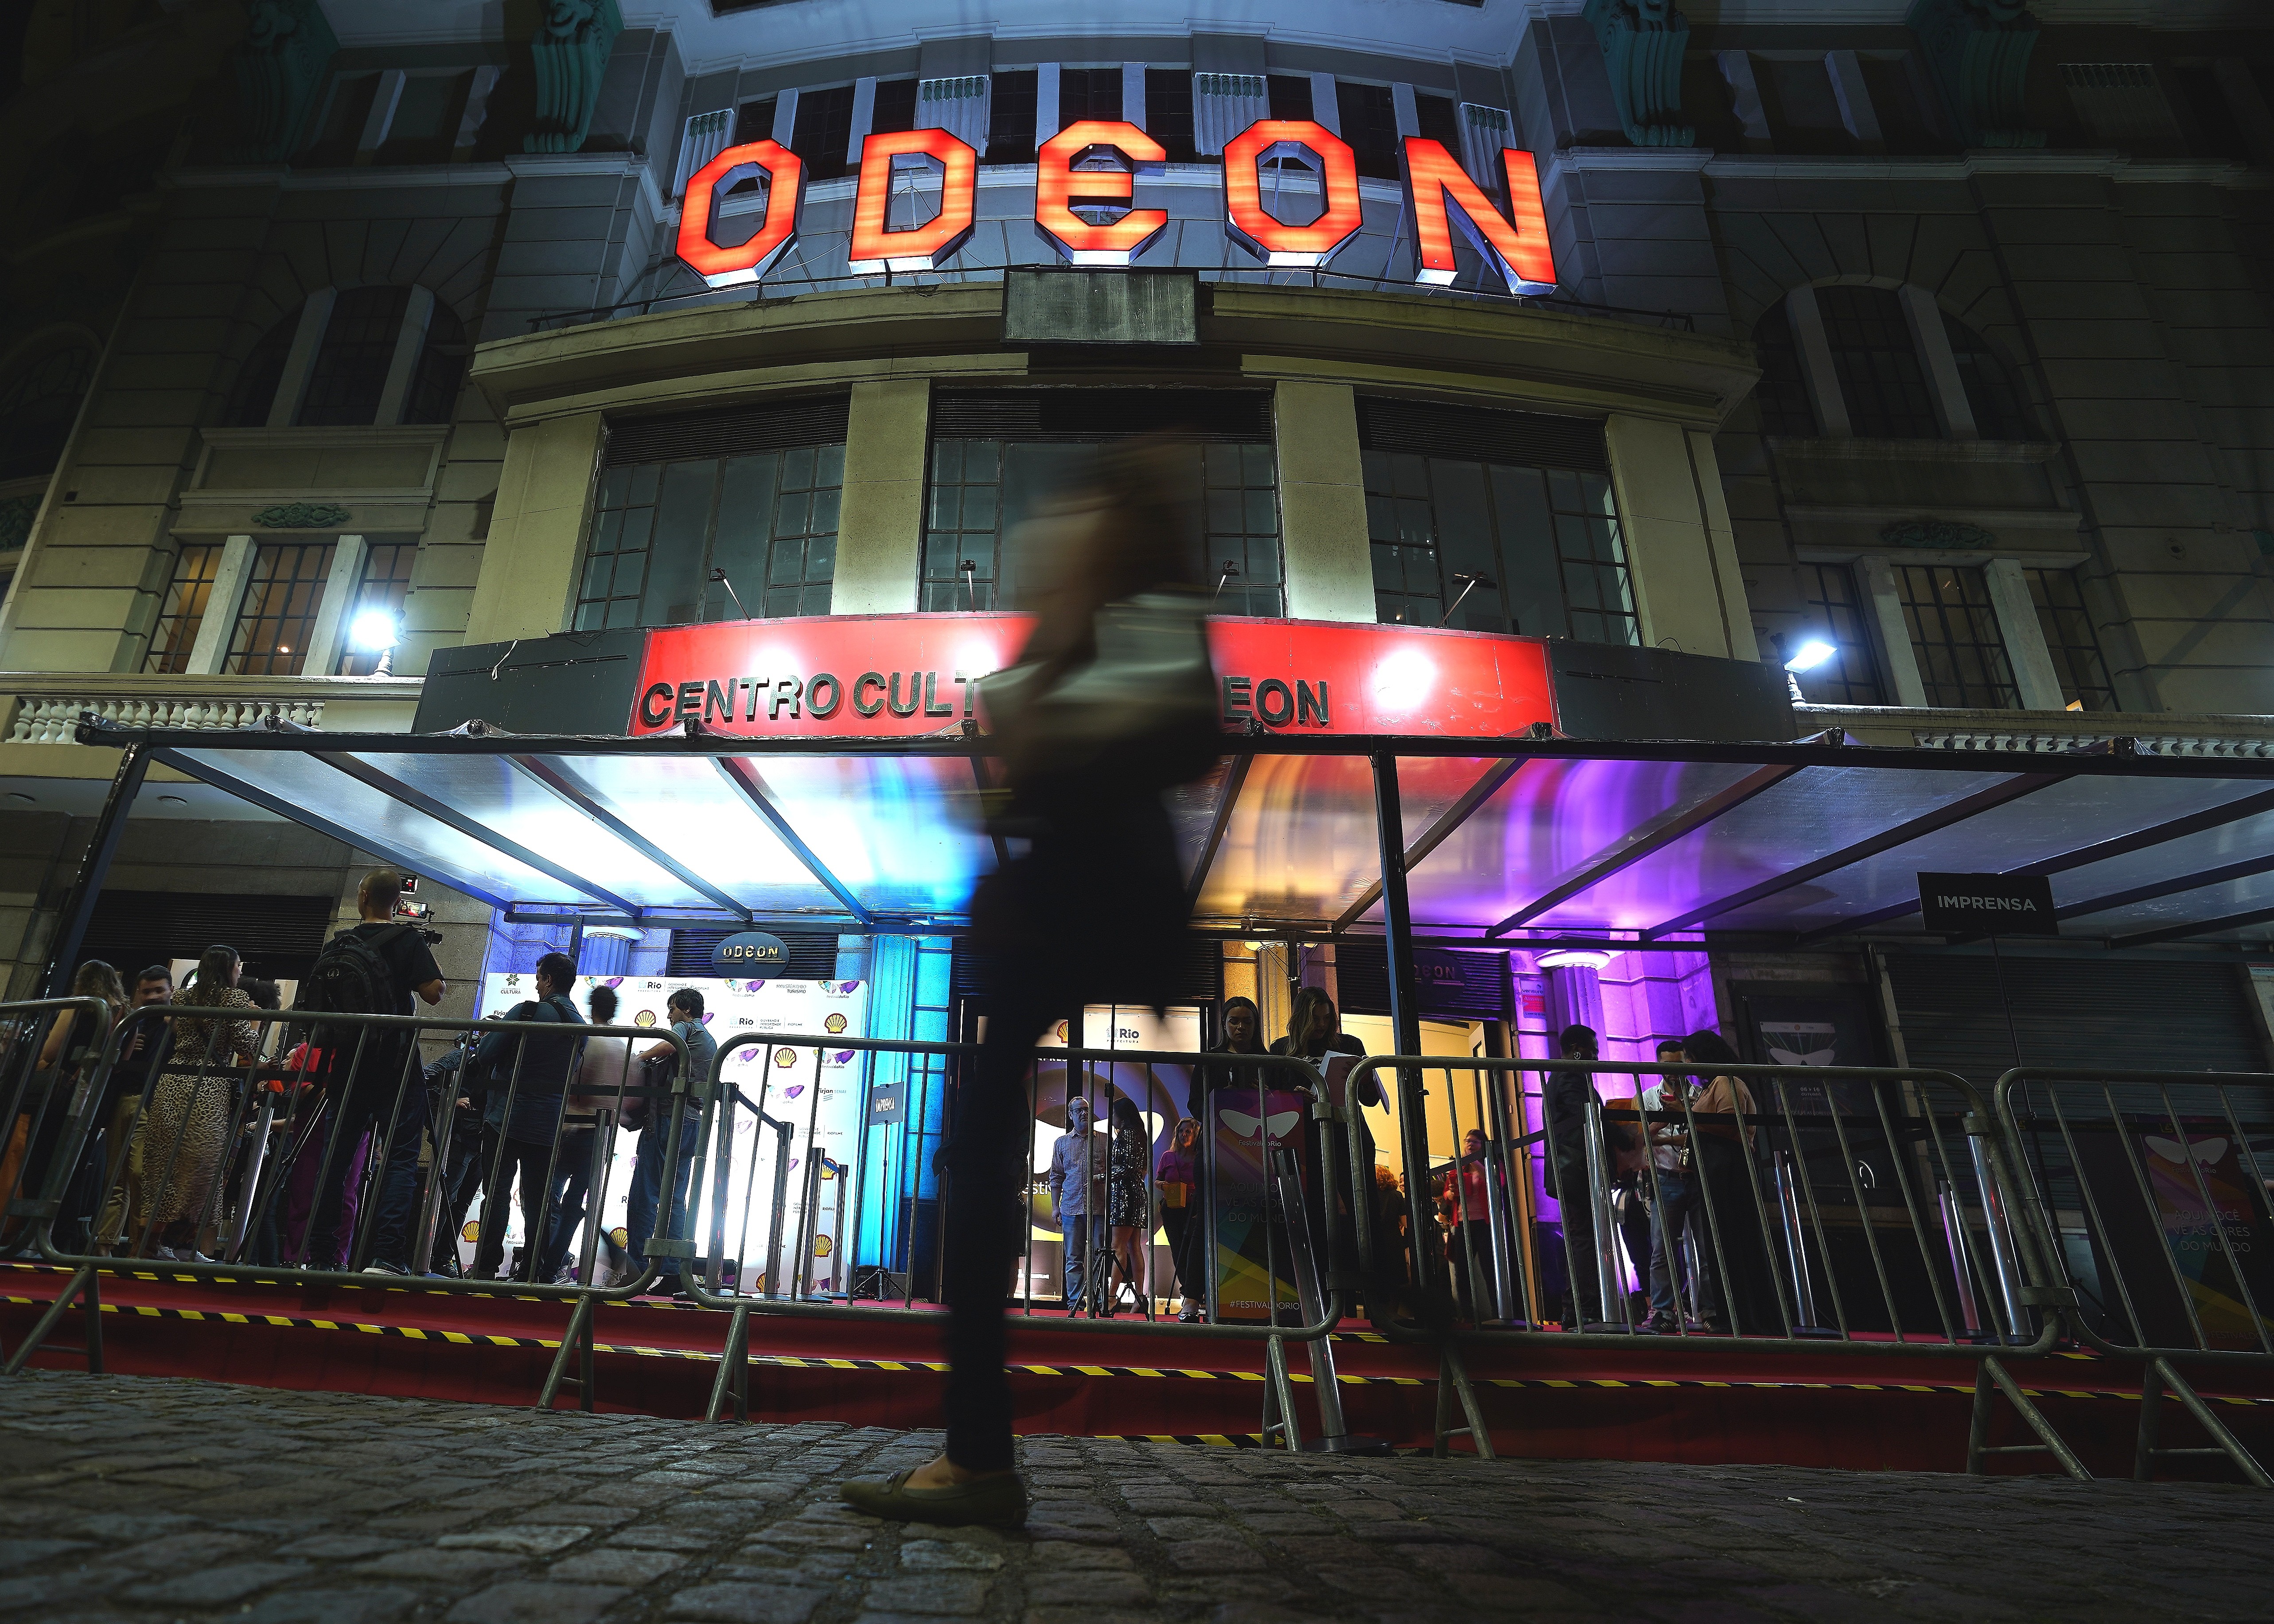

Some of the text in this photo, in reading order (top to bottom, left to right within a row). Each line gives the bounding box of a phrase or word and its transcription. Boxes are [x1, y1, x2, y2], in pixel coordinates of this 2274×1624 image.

[675, 119, 1557, 296] ODEON
[640, 670, 1329, 727] CENTRO CULT EON
[1938, 896, 2037, 911] IMPRENSA
[723, 945, 779, 958] ODEON
[1120, 1028, 1139, 1038] Rio
[875, 1097, 895, 1113] IMPRENSA
[1230, 1183, 1258, 1193] AQUI
[1243, 1198, 1257, 1207] AS
[1229, 1212, 1286, 1223] DO MUND
[2175, 1210, 2205, 1221] AQUI
[2173, 1224, 2188, 1235] VÊ
[2193, 1226, 2207, 1236] AS
[2181, 1241, 2251, 1252] DO MUDO
[1230, 1300, 1300, 1310] #FESTIVALORIO
